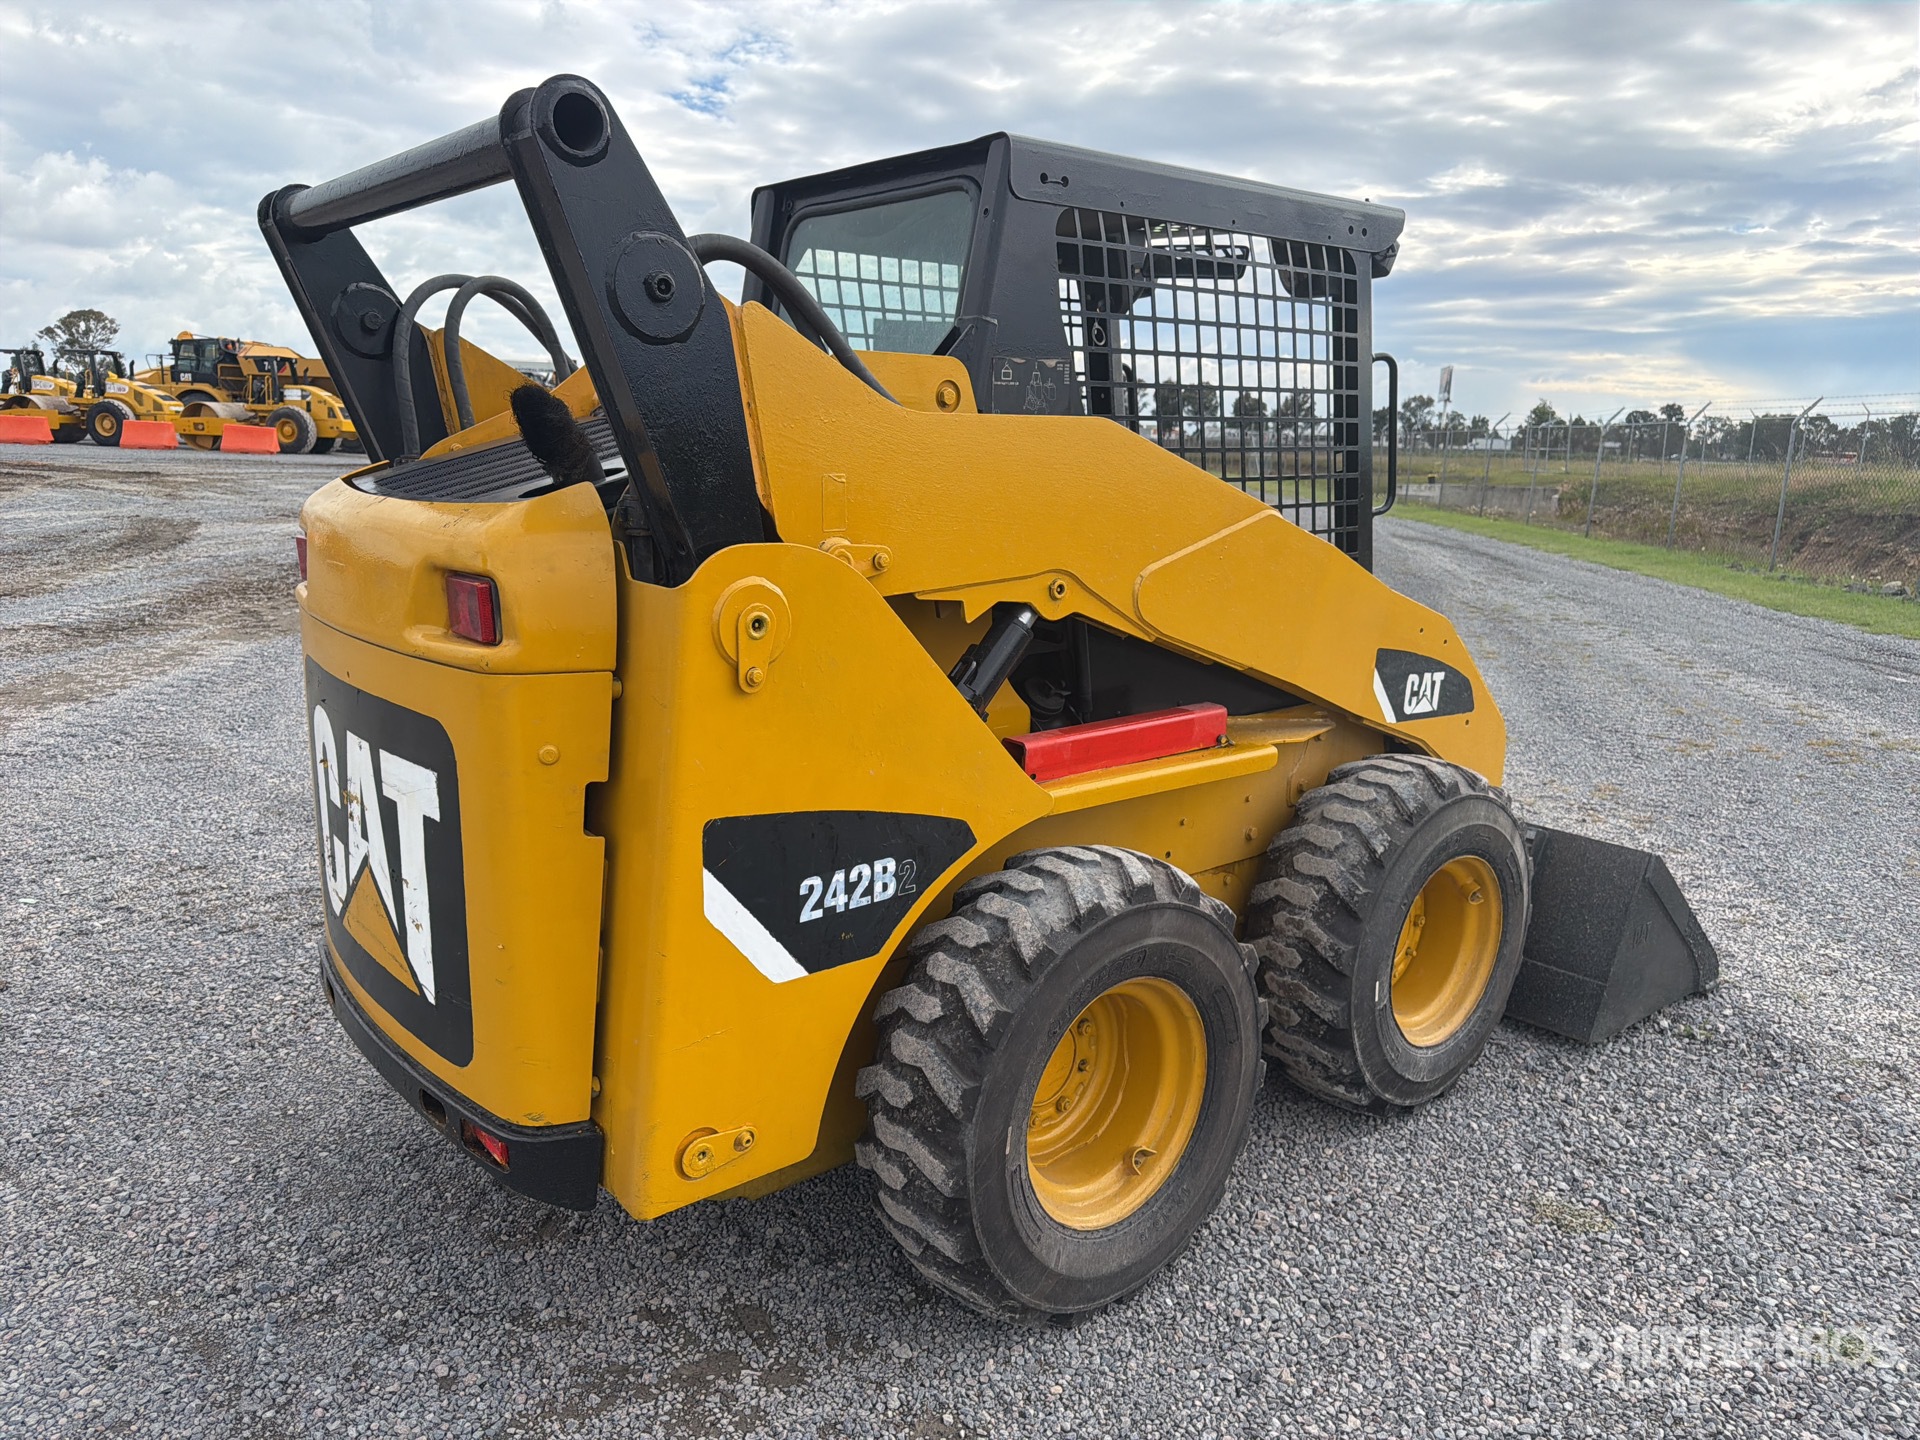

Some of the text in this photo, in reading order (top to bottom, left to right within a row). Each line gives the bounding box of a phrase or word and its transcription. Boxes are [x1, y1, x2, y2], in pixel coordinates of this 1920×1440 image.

[180, 372, 192, 381] CAT
[1403, 671, 1446, 715] CAT
[313, 704, 441, 1006] CAT
